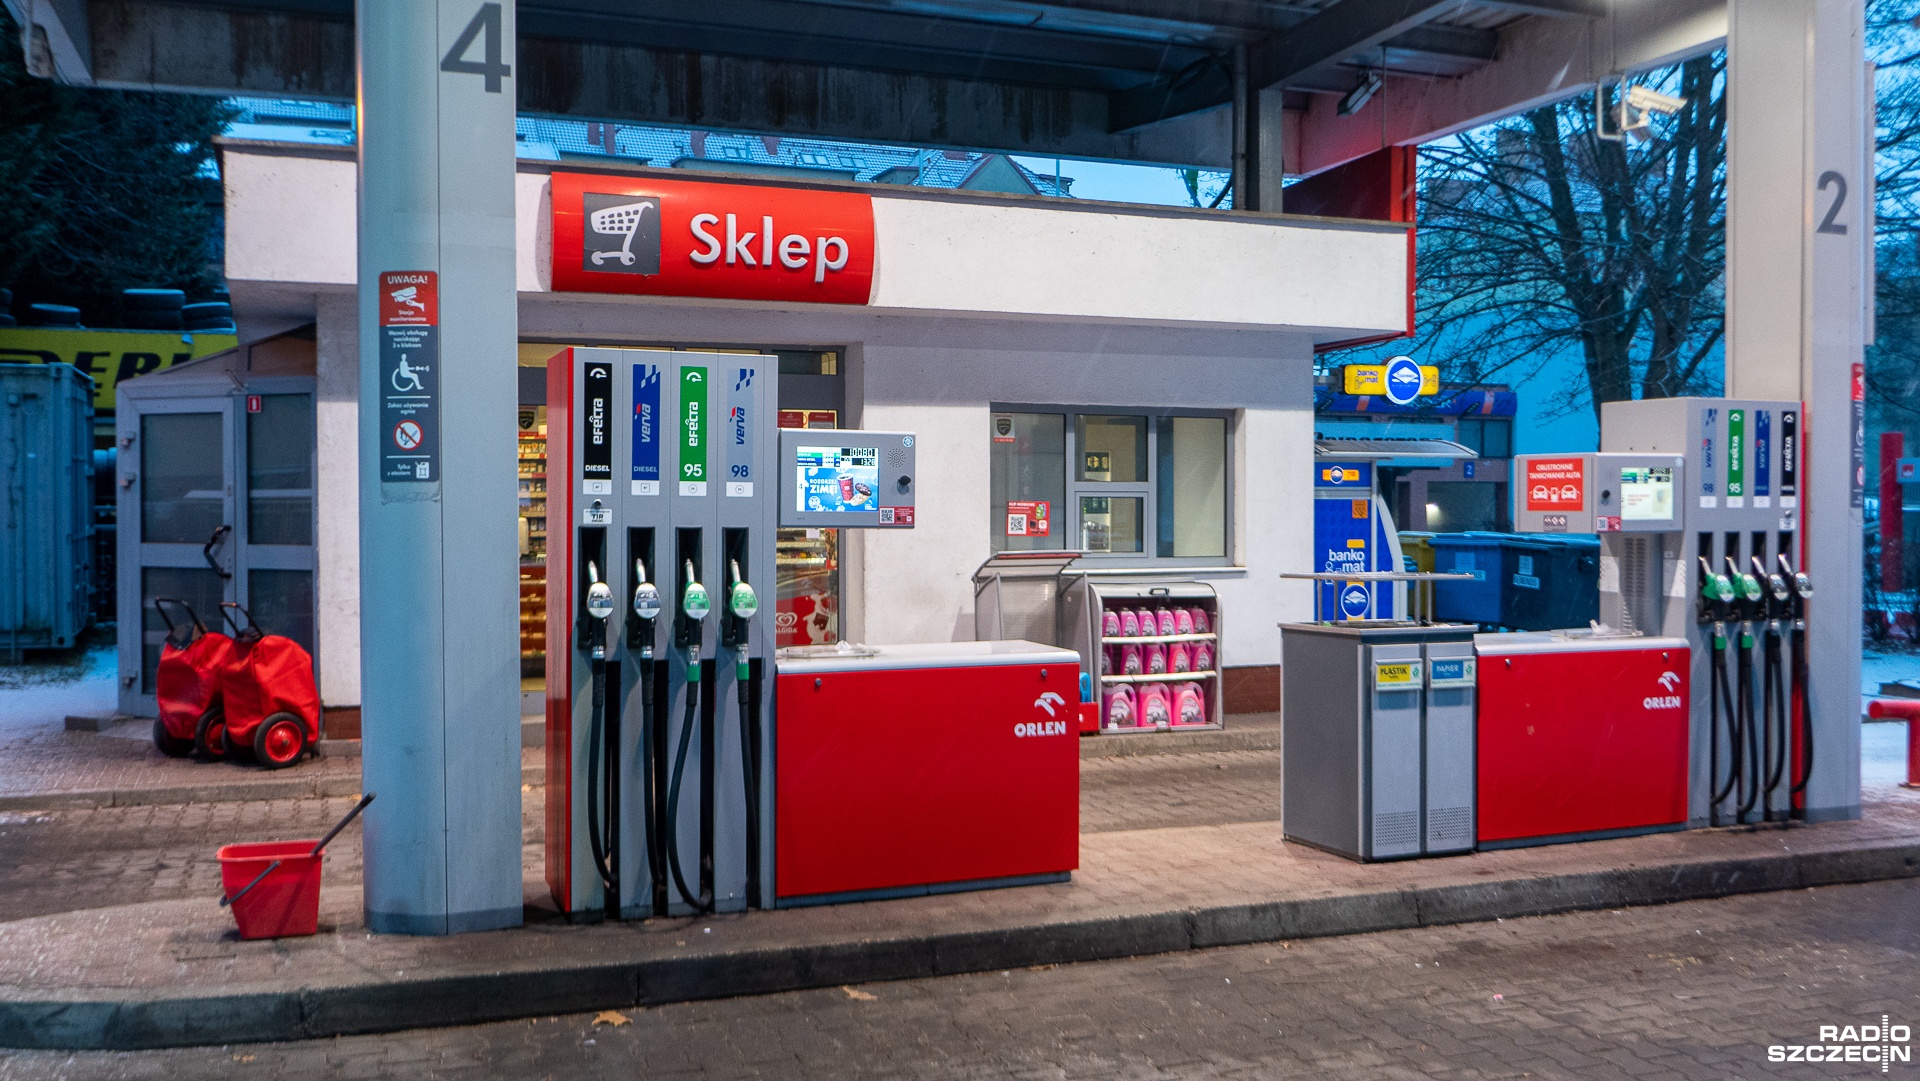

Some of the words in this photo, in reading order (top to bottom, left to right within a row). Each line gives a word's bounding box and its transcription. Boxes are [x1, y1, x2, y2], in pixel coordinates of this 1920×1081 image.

[440, 2, 511, 93] 4
[1816, 170, 1847, 235] 2
[689, 212, 849, 283] Sklep
[387, 275, 428, 284] UWAGA!
[1357, 369, 1379, 377] banko
[640, 402, 652, 443] verva
[735, 406, 746, 445] verva
[585, 464, 611, 472] DIESEL
[633, 465, 658, 473] DIESEL
[683, 463, 703, 477] 95
[731, 464, 749, 478] 98
[1466, 464, 1473, 475] 2
[1535, 463, 1574, 471] OBUSTRONNE
[1529, 472, 1565, 480] TANKOWANIE
[1565, 471, 1581, 479] AUTA
[1328, 548, 1365, 561] banko
[1342, 561, 1365, 572] mat
[1380, 666, 1408, 675] PLASTIK
[1436, 664, 1459, 672] PAPIER
[1643, 696, 1682, 710] ORLEN
[1014, 721, 1067, 738] ORLEN
